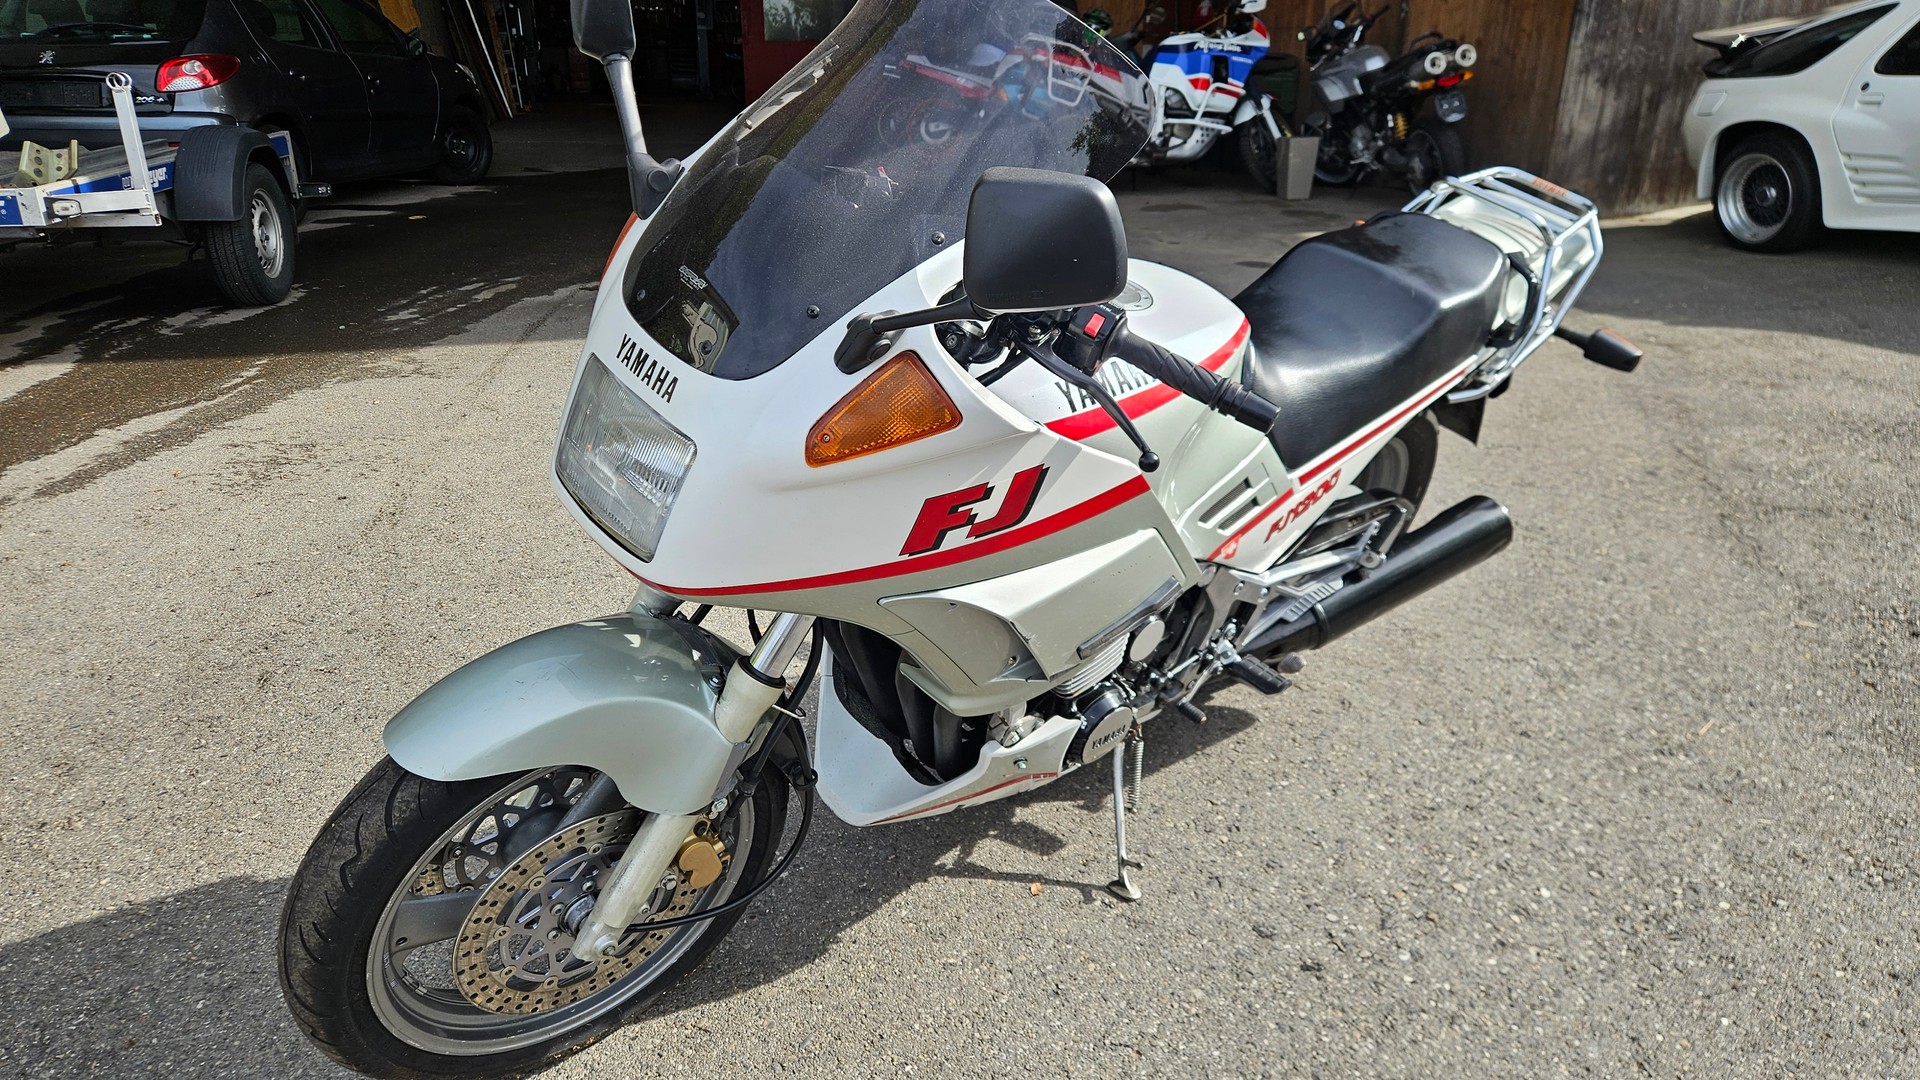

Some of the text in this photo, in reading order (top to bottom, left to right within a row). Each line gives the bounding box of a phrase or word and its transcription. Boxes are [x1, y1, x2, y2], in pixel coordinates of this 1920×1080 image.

[616, 333, 679, 403] YAMAHA
[1054, 360, 1157, 414] YAMAH
[898, 463, 1051, 557] FJ
[1091, 724, 1127, 750] YAMAHA
